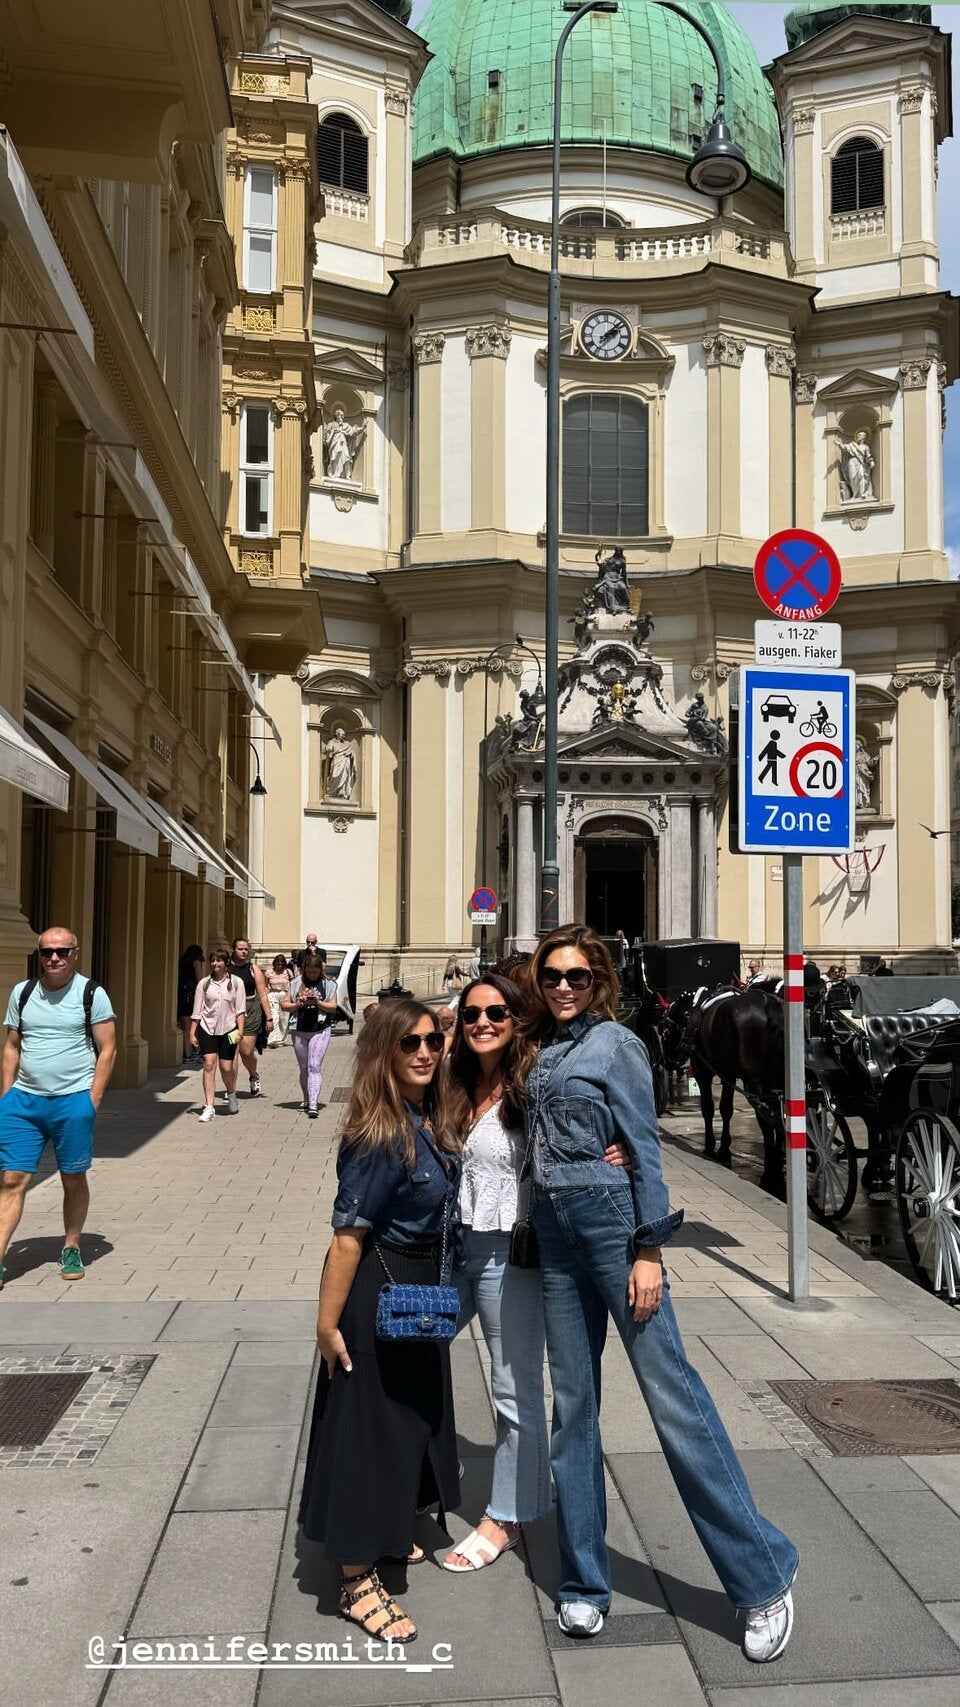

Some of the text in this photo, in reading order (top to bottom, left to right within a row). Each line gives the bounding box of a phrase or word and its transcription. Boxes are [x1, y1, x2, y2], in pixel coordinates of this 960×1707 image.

[775, 603, 823, 620] ANFANG
[759, 646, 837, 659] ausgen. Fiaker
[806, 759, 837, 790] 20
[764, 805, 831, 832] Zone
